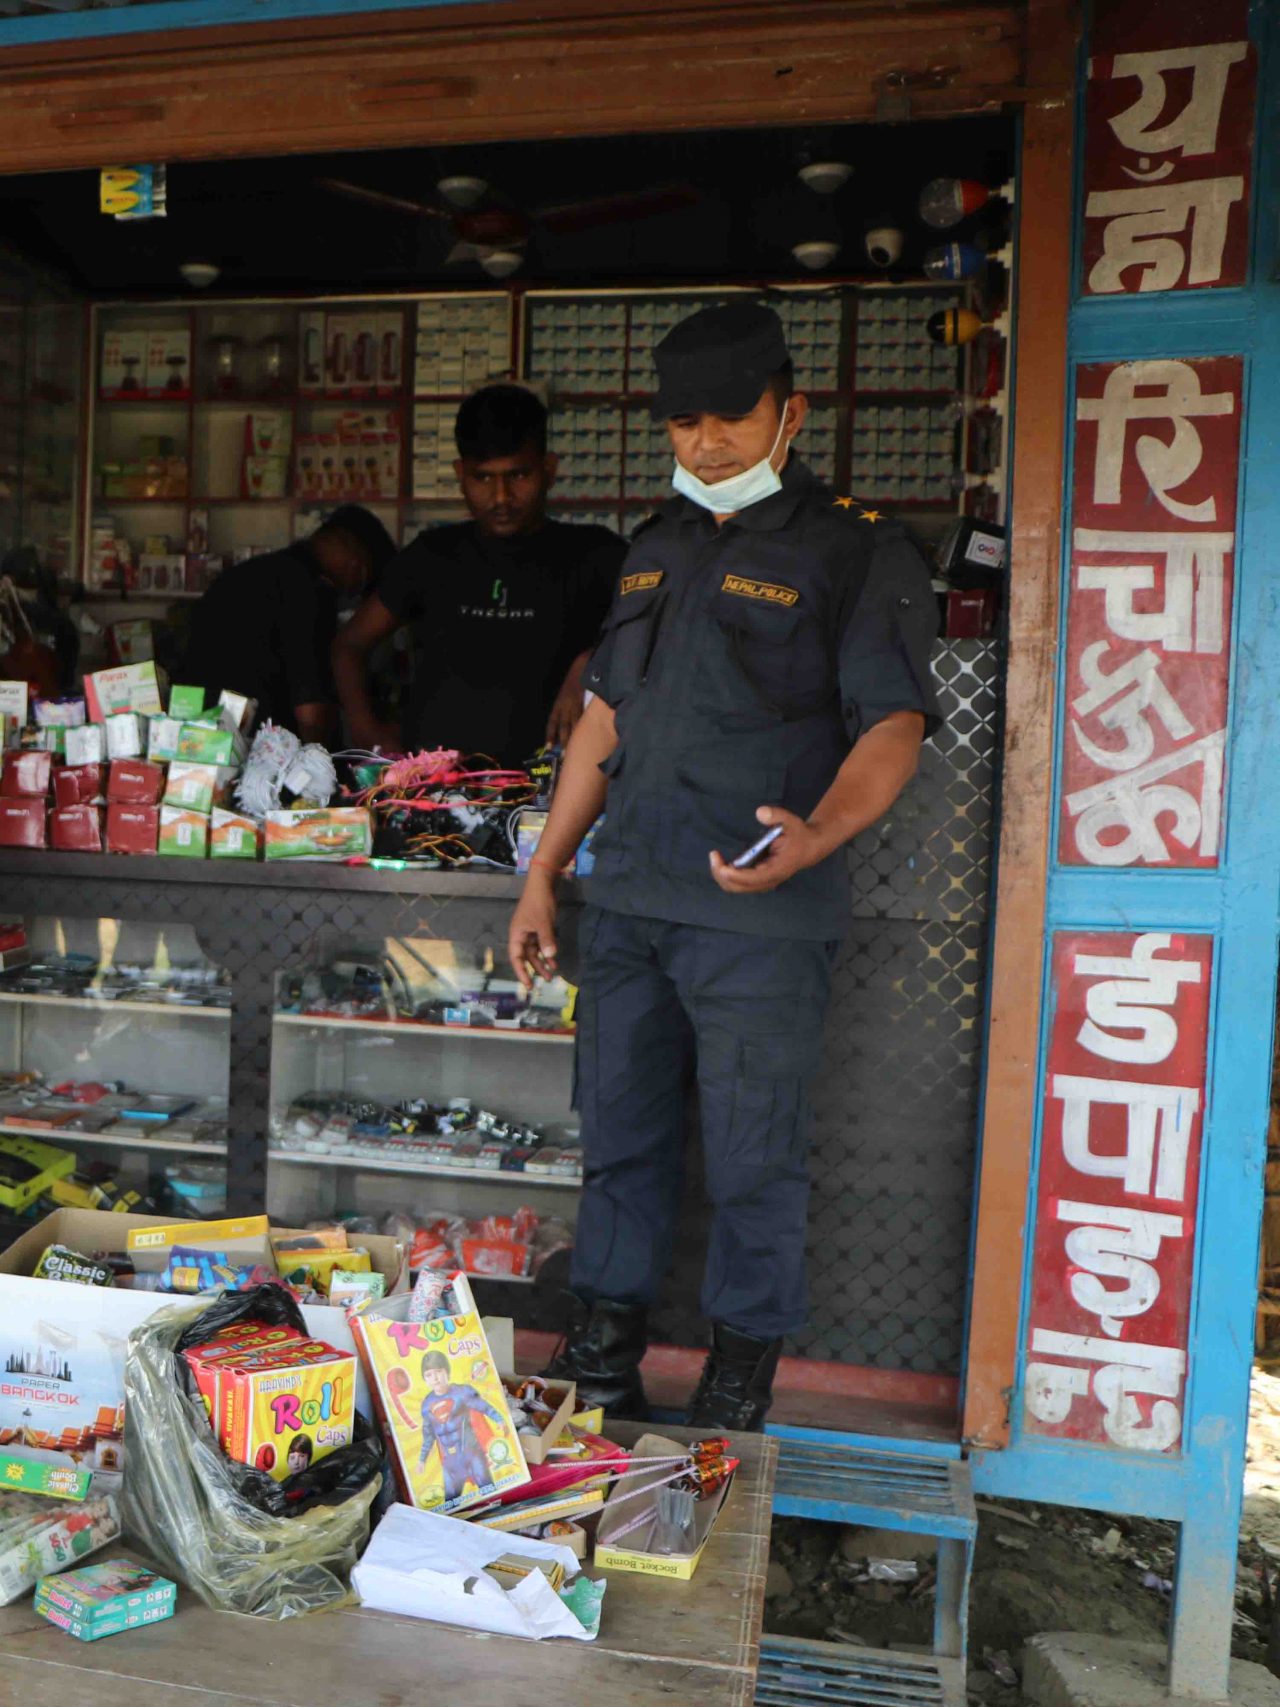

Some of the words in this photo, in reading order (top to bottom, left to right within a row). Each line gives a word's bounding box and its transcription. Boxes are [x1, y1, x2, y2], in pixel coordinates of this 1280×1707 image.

[44, 1256, 107, 1281] Classic
[448, 1338, 481, 1356] Caps
[21, 1378, 61, 1389] PAPER
[1, 1384, 80, 1405] BANGKOK
[271, 1376, 344, 1434] Roll
[316, 1425, 347, 1446] Caps
[606, 1556, 637, 1569] Bomb
[639, 1561, 678, 1574] Rocket
